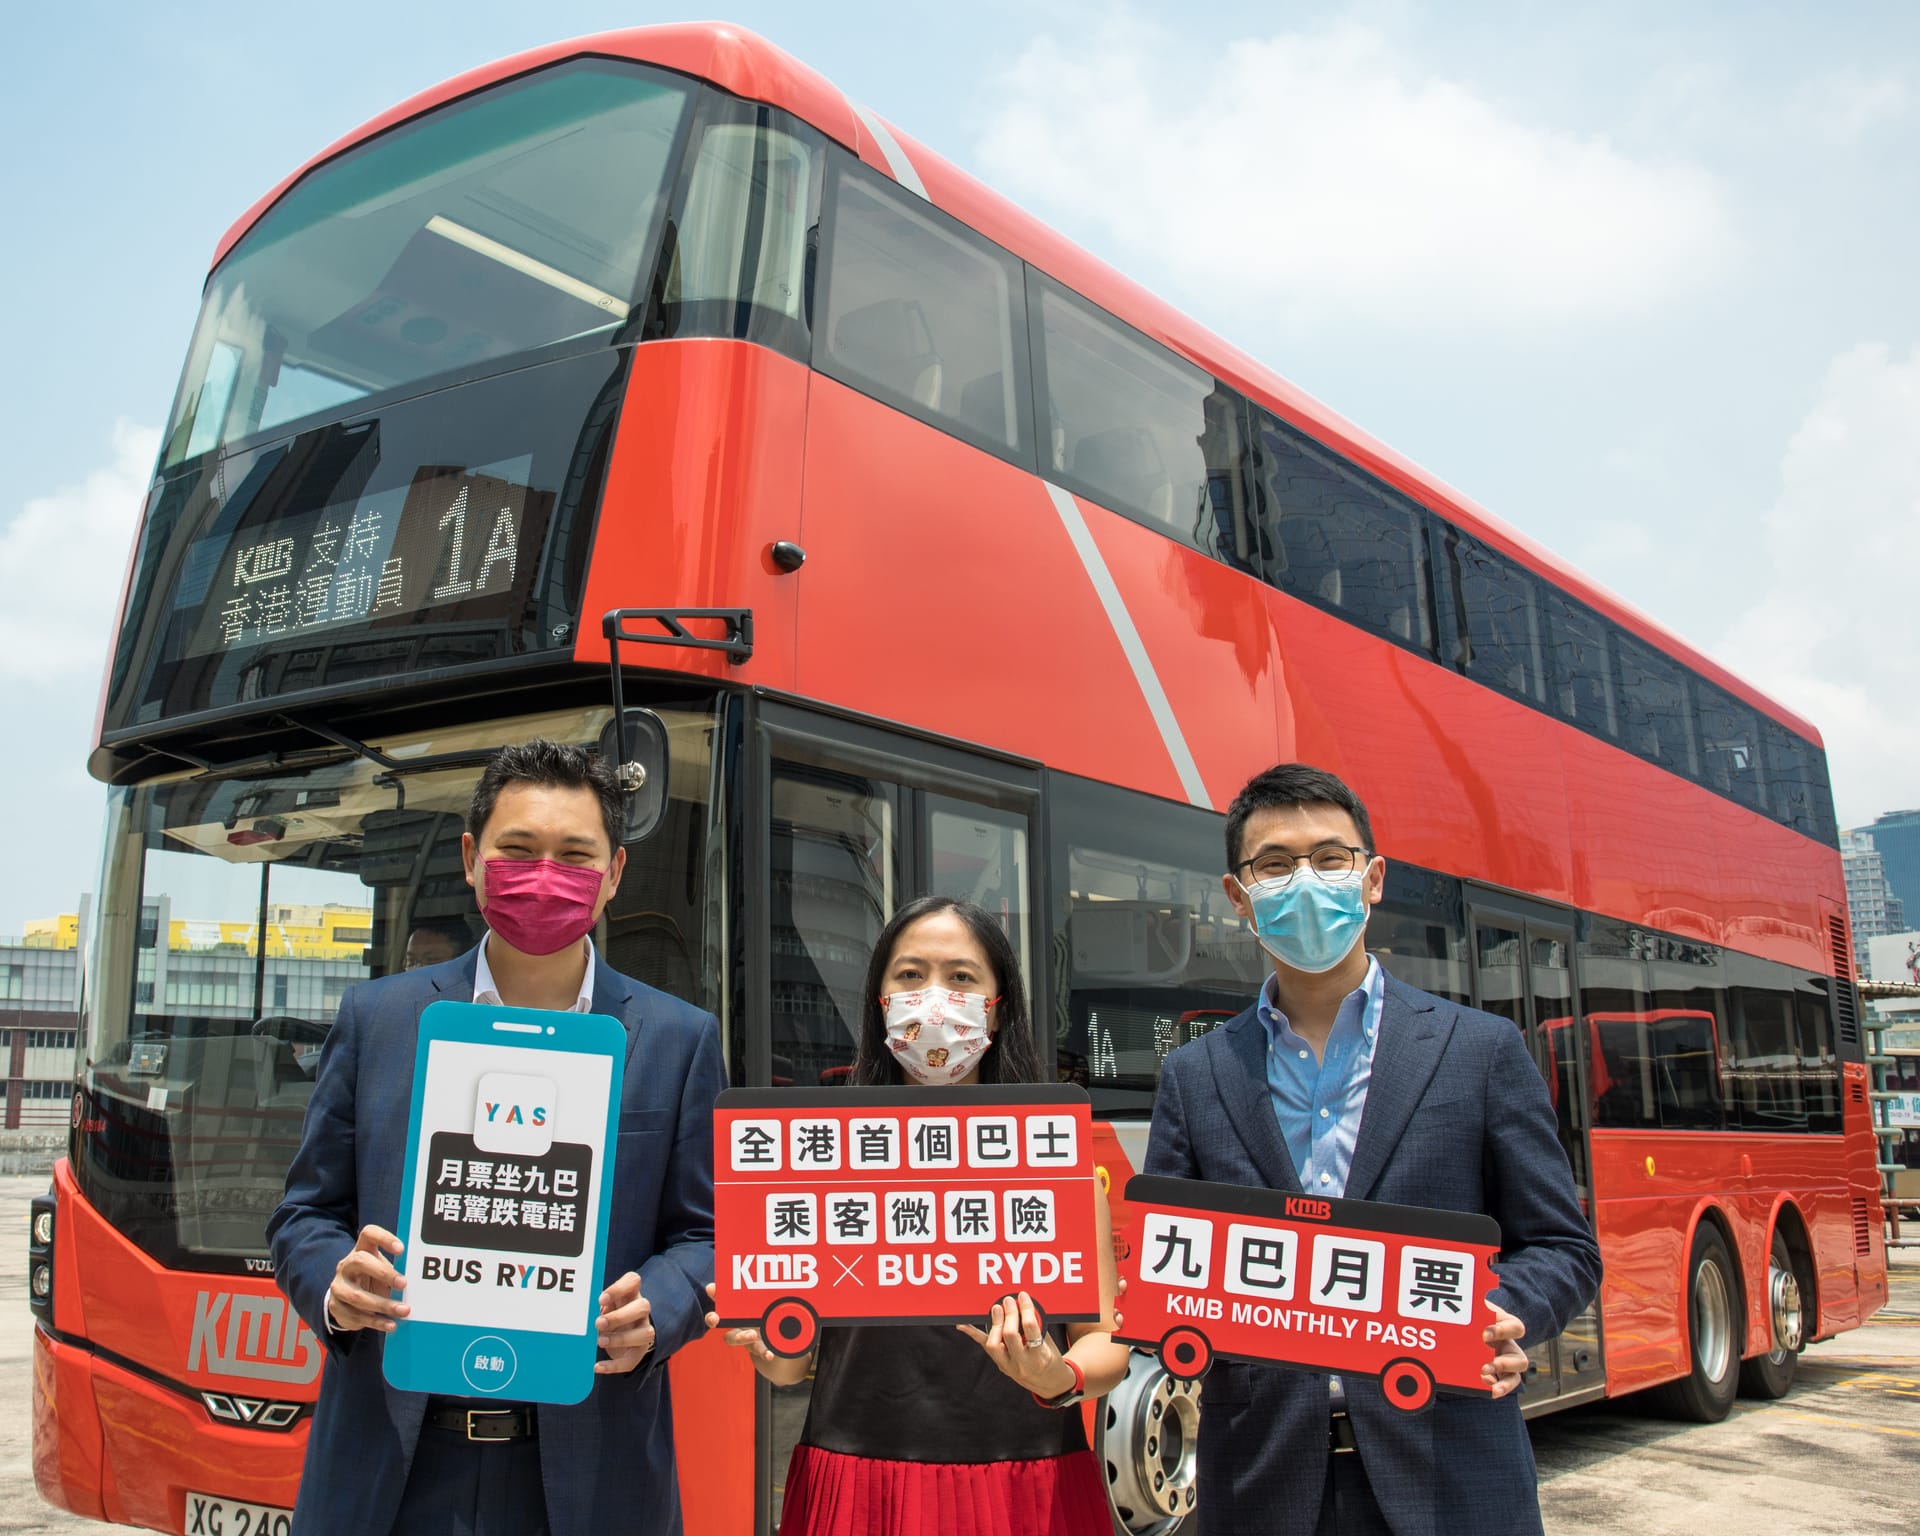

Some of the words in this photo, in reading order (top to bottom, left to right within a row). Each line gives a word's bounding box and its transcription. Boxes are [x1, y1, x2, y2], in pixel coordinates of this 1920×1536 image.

[233, 537, 294, 587] KMB
[306, 510, 382, 573] 支持
[434, 485, 518, 599] 1A
[220, 557, 402, 644] 香港運動員
[1088, 1012, 1117, 1077] 1A
[485, 1102, 547, 1127] YAS
[738, 1121, 1071, 1164] 全港首個巴士
[436, 1158, 579, 1198] 月票坐九巴
[434, 1193, 577, 1233] 唔驚跌電話
[773, 1196, 1048, 1239] 乘客微保險
[1285, 1196, 1331, 1221] KMB
[244, 1258, 275, 1272] VOL
[421, 1256, 482, 1284] BUS
[497, 1262, 576, 1293] RYDE
[732, 1254, 819, 1290] KMB
[877, 1253, 958, 1286] BUS
[978, 1251, 1084, 1285] RYDE
[1151, 1225, 1463, 1314] 九巴月票
[1166, 1293, 1223, 1321] KMB
[1231, 1303, 1359, 1340] MONTHLY
[1366, 1320, 1437, 1351] PASS
[192, 1498, 223, 1536] XG
[235, 1508, 291, 1536] 240
